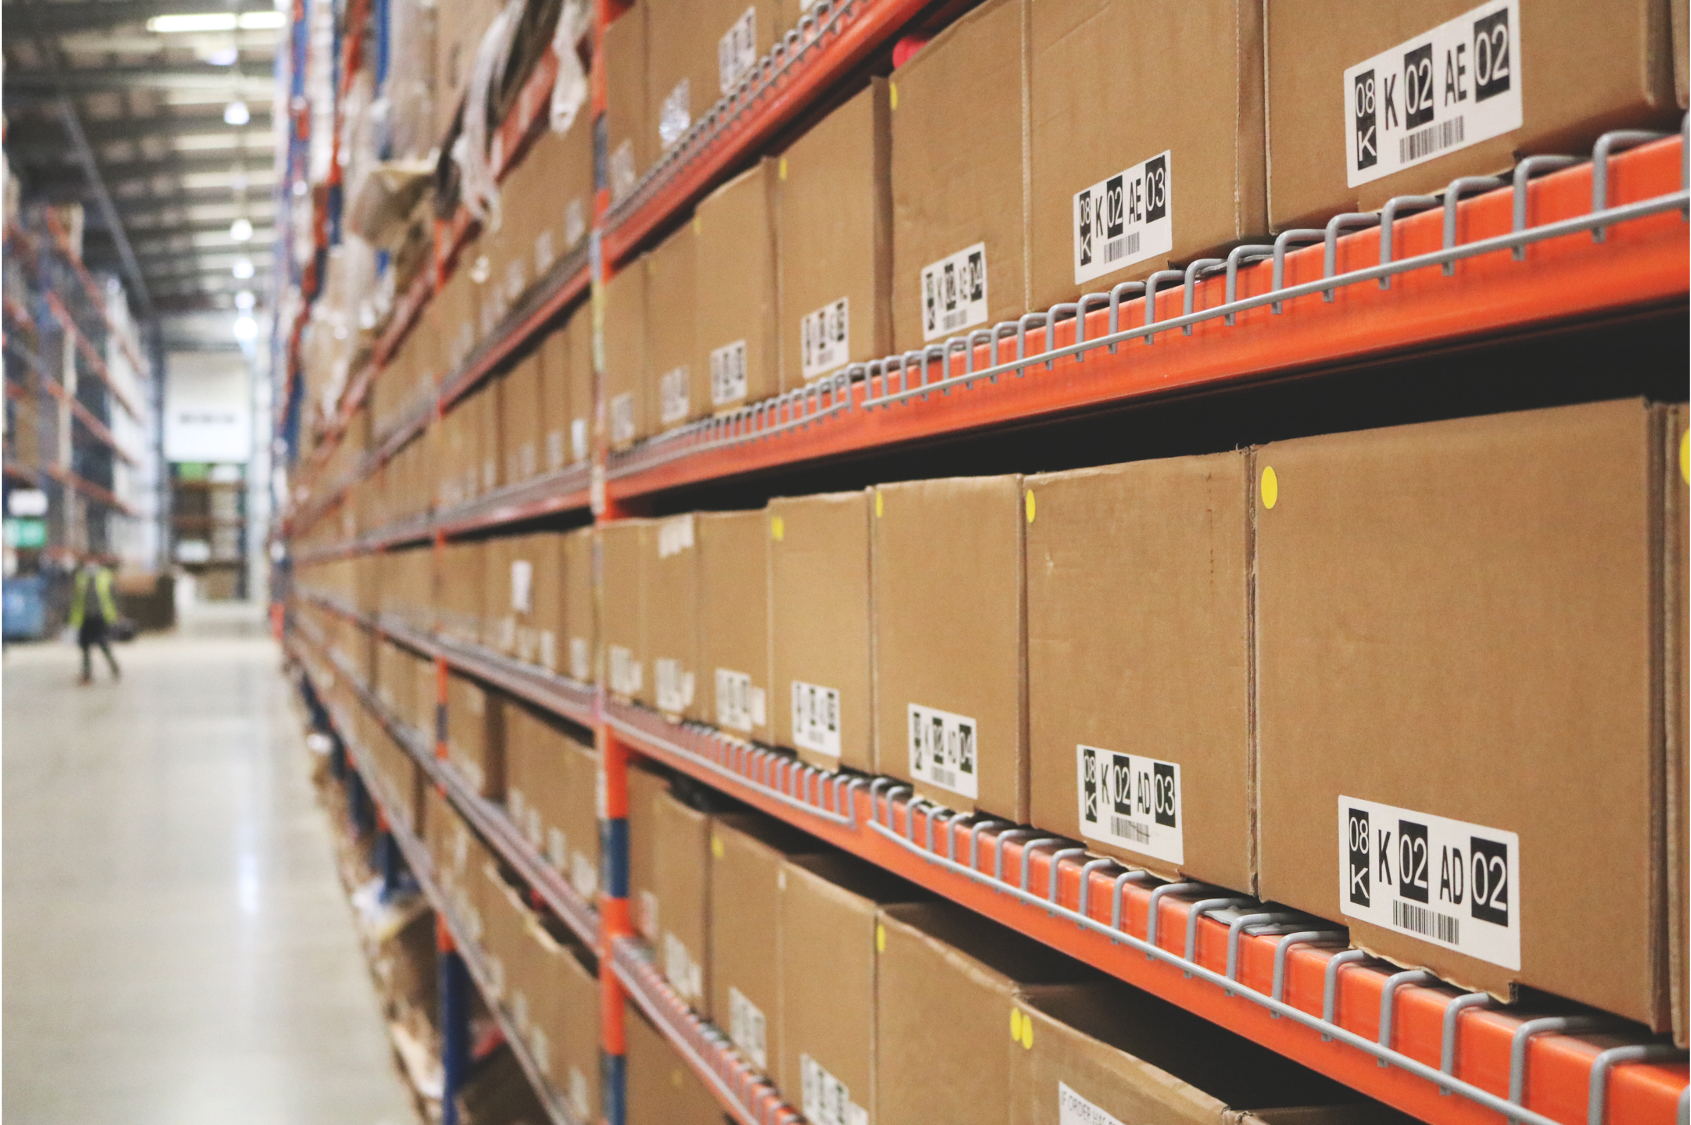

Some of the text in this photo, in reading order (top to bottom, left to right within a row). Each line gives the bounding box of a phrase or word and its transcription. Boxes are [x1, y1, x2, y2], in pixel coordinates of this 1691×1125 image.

[1384, 24, 1509, 131] K 02 AE 02
[1355, 79, 1376, 118] 08
[1357, 125, 1377, 162] K
[1080, 197, 1091, 227] 08
[1095, 167, 1165, 239] K 02 AE 03
[1080, 233, 1092, 260] K
[969, 260, 982, 294] 04
[959, 731, 973, 764] 04
[1084, 755, 1096, 783] 08
[1085, 791, 1097, 817] K
[1101, 763, 1175, 816] K 02 AD 03
[1349, 816, 1369, 854] 08
[1351, 863, 1370, 899] K
[1378, 829, 1507, 912] K 02 AD 02
[1068, 1094, 1091, 1123] ORDER
